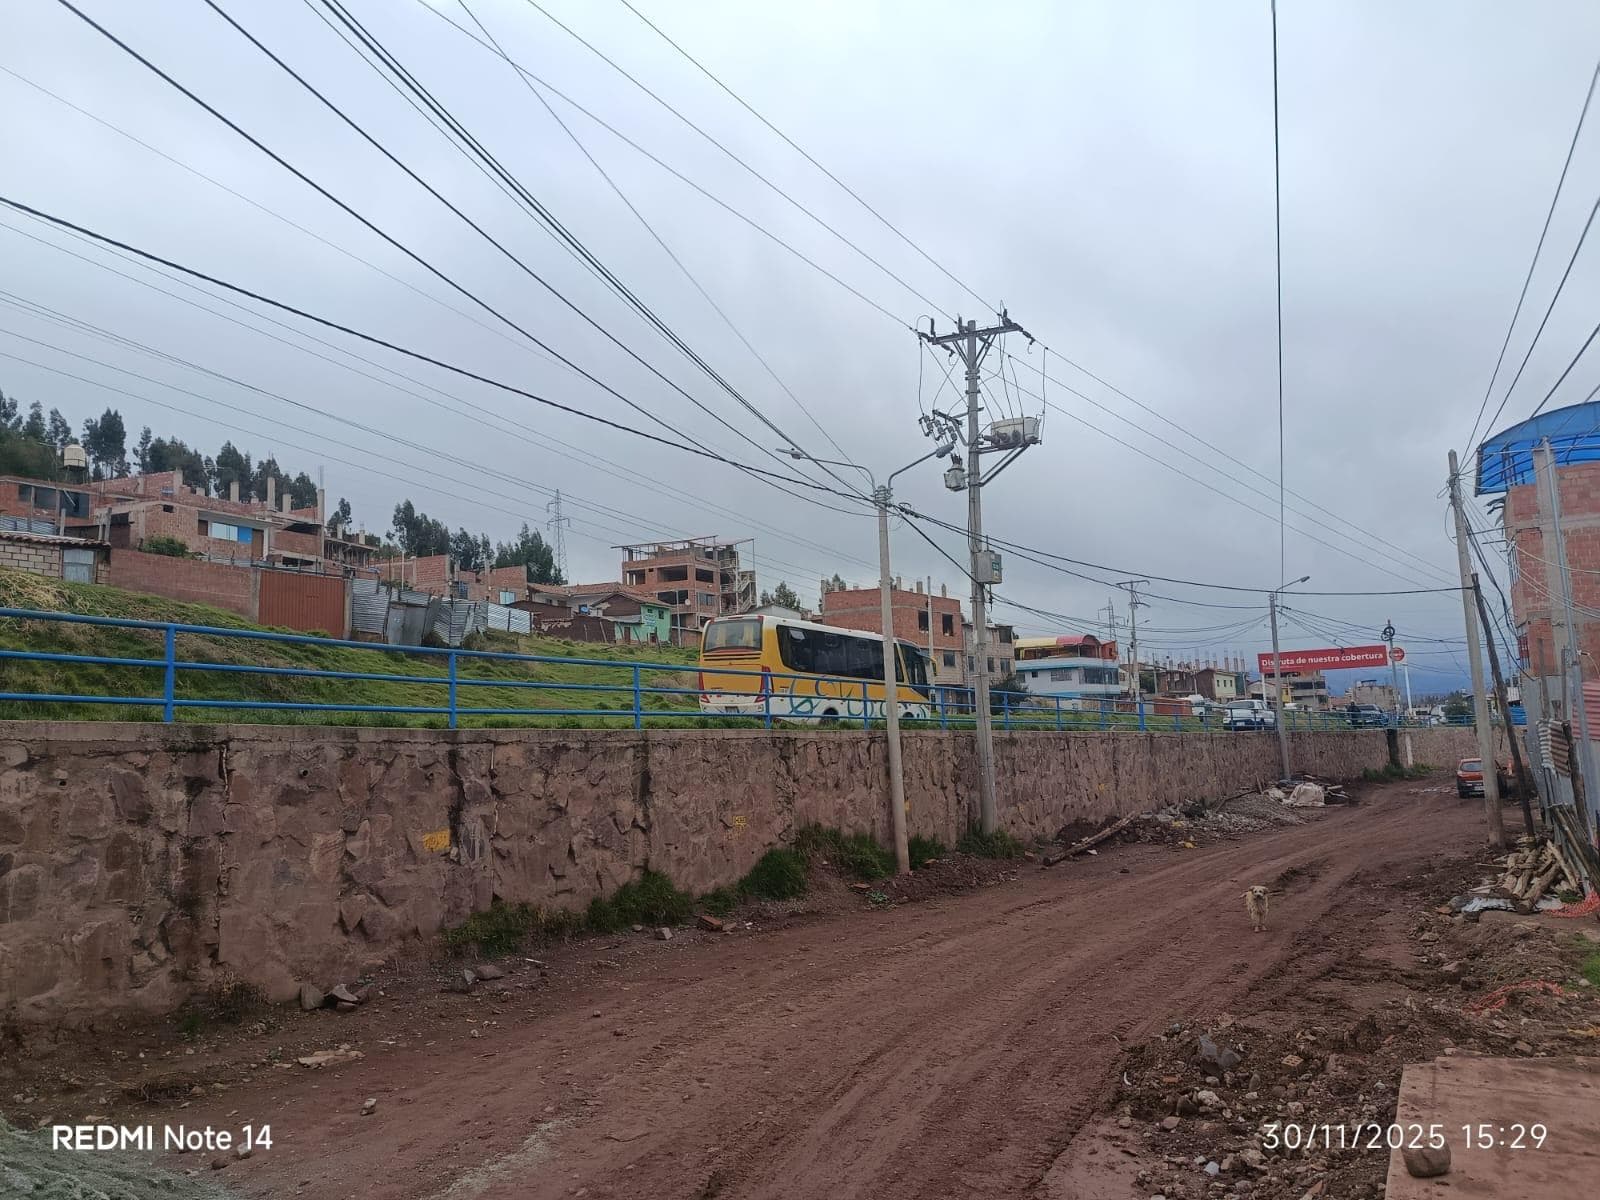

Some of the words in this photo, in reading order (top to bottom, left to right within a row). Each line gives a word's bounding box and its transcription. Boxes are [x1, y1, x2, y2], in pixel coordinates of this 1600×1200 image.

[1261, 657, 1295, 666] Disruta
[1296, 656, 1307, 664] de
[1308, 655, 1340, 664] nuestra
[1341, 653, 1384, 662] cobertura
